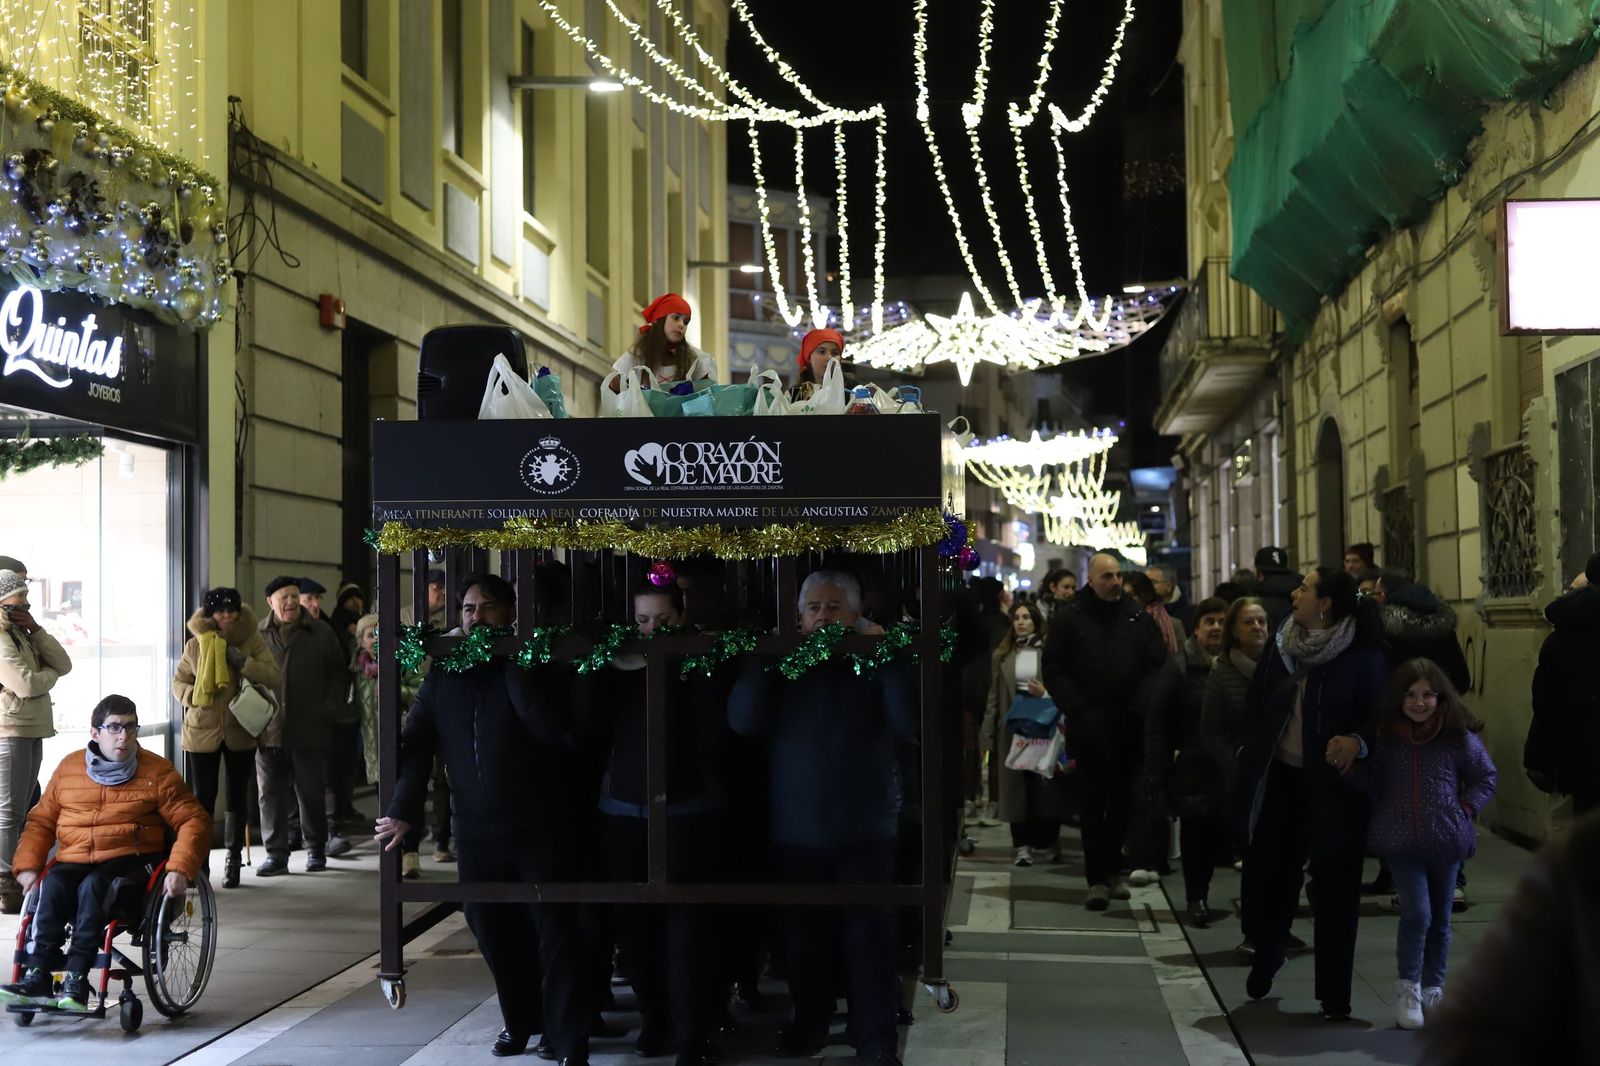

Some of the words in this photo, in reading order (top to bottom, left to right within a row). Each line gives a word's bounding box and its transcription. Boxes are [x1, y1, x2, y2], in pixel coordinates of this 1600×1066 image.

[0, 284, 124, 388] Quintas
[88, 382, 121, 403] JOYEROS
[662, 435, 782, 465] CORAZÓN
[664, 462, 698, 485] DE
[700, 462, 784, 485] MADRE
[383, 509, 413, 520] MESA
[415, 508, 485, 519] ITINERANTE
[487, 508, 547, 519] SOLIDARIA
[551, 508, 577, 518] REAL
[579, 506, 640, 518] COFRADÍA
[643, 508, 658, 518] DE
[661, 507, 714, 517] NUESTRA
[716, 507, 758, 517] MADRE
[762, 507, 777, 517] DE
[780, 507, 800, 517] LAS
[801, 506, 869, 517] ANGUSTIAS
